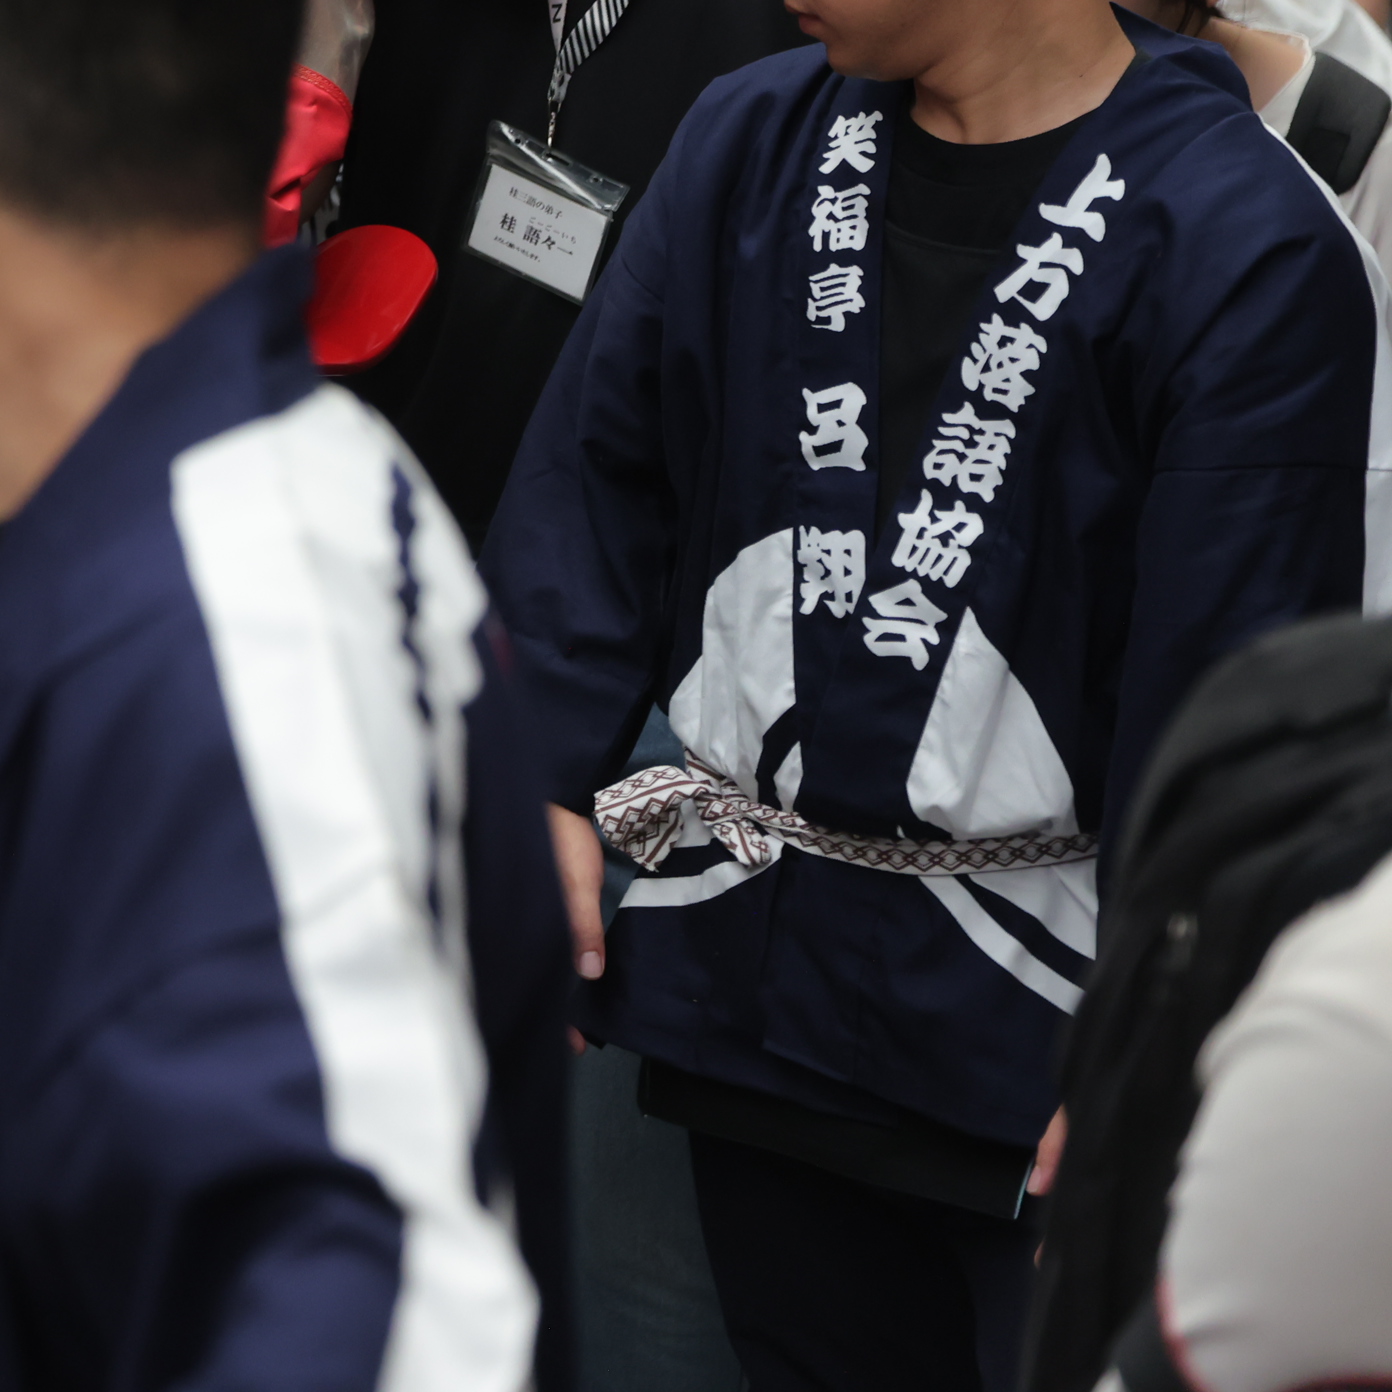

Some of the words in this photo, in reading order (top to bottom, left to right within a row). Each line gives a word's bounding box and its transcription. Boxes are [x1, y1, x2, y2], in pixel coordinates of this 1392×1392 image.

[551, 3, 563, 24] N
[861, 153, 1126, 672] 上方落語協会
